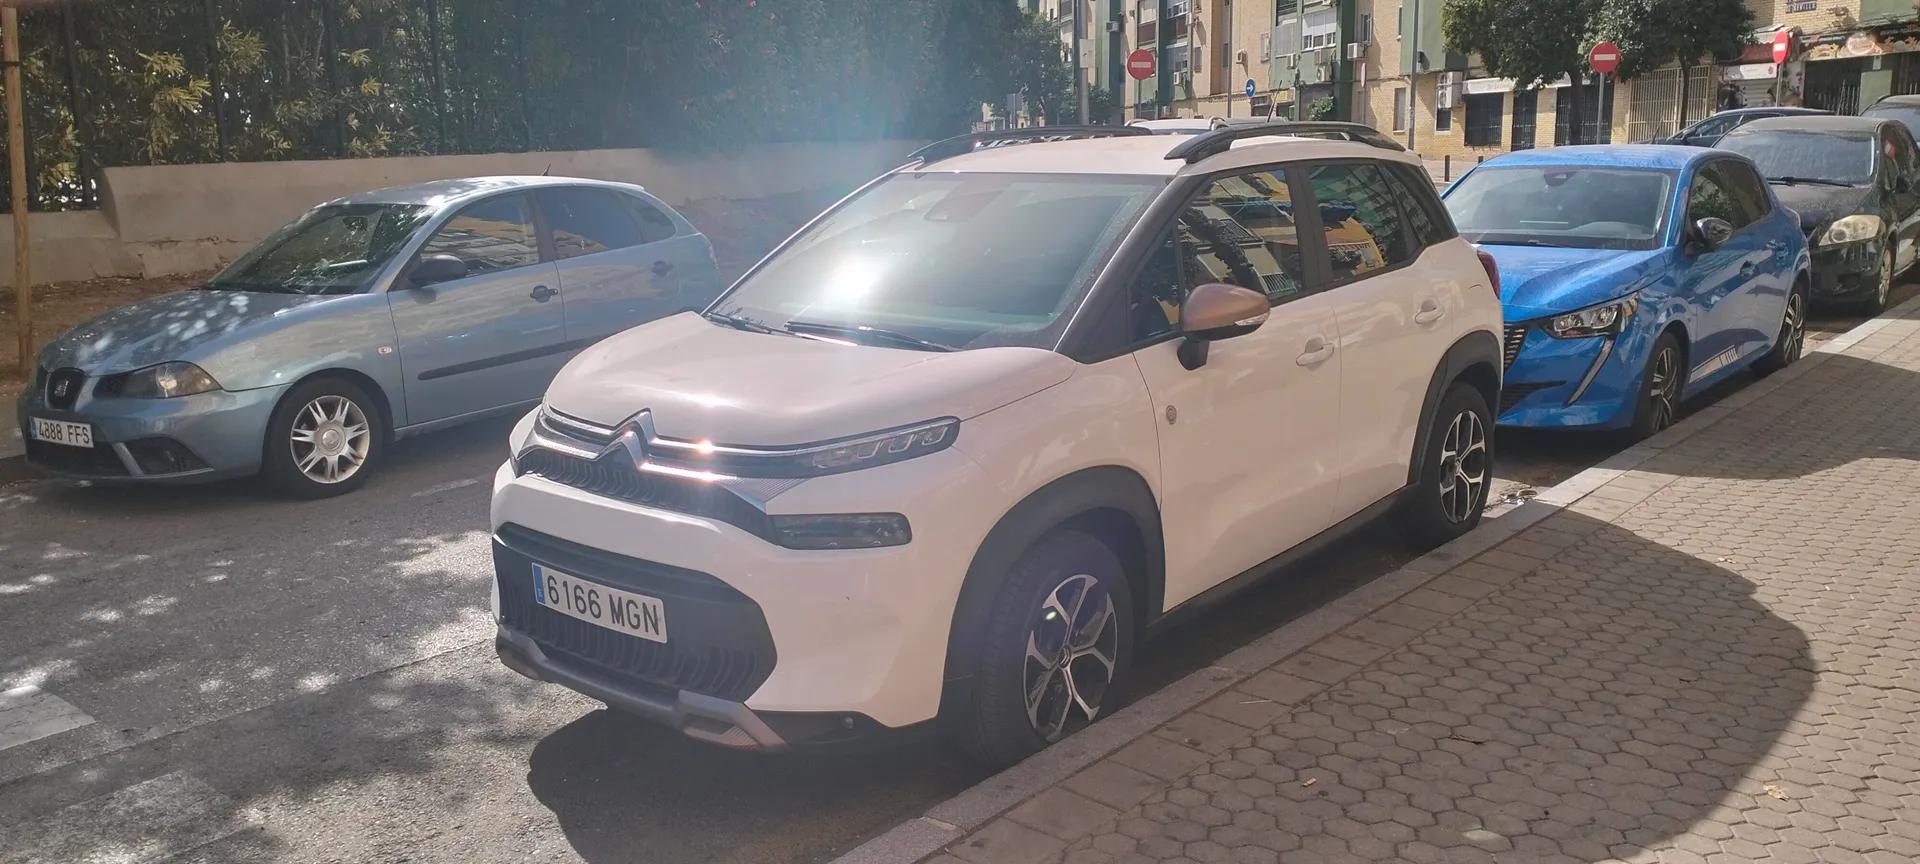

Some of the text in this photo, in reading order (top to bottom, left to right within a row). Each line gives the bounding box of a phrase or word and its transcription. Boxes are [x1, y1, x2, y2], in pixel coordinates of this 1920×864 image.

[39, 420, 90, 444] 4888 FFS
[547, 575, 660, 636] 6166 MGN
